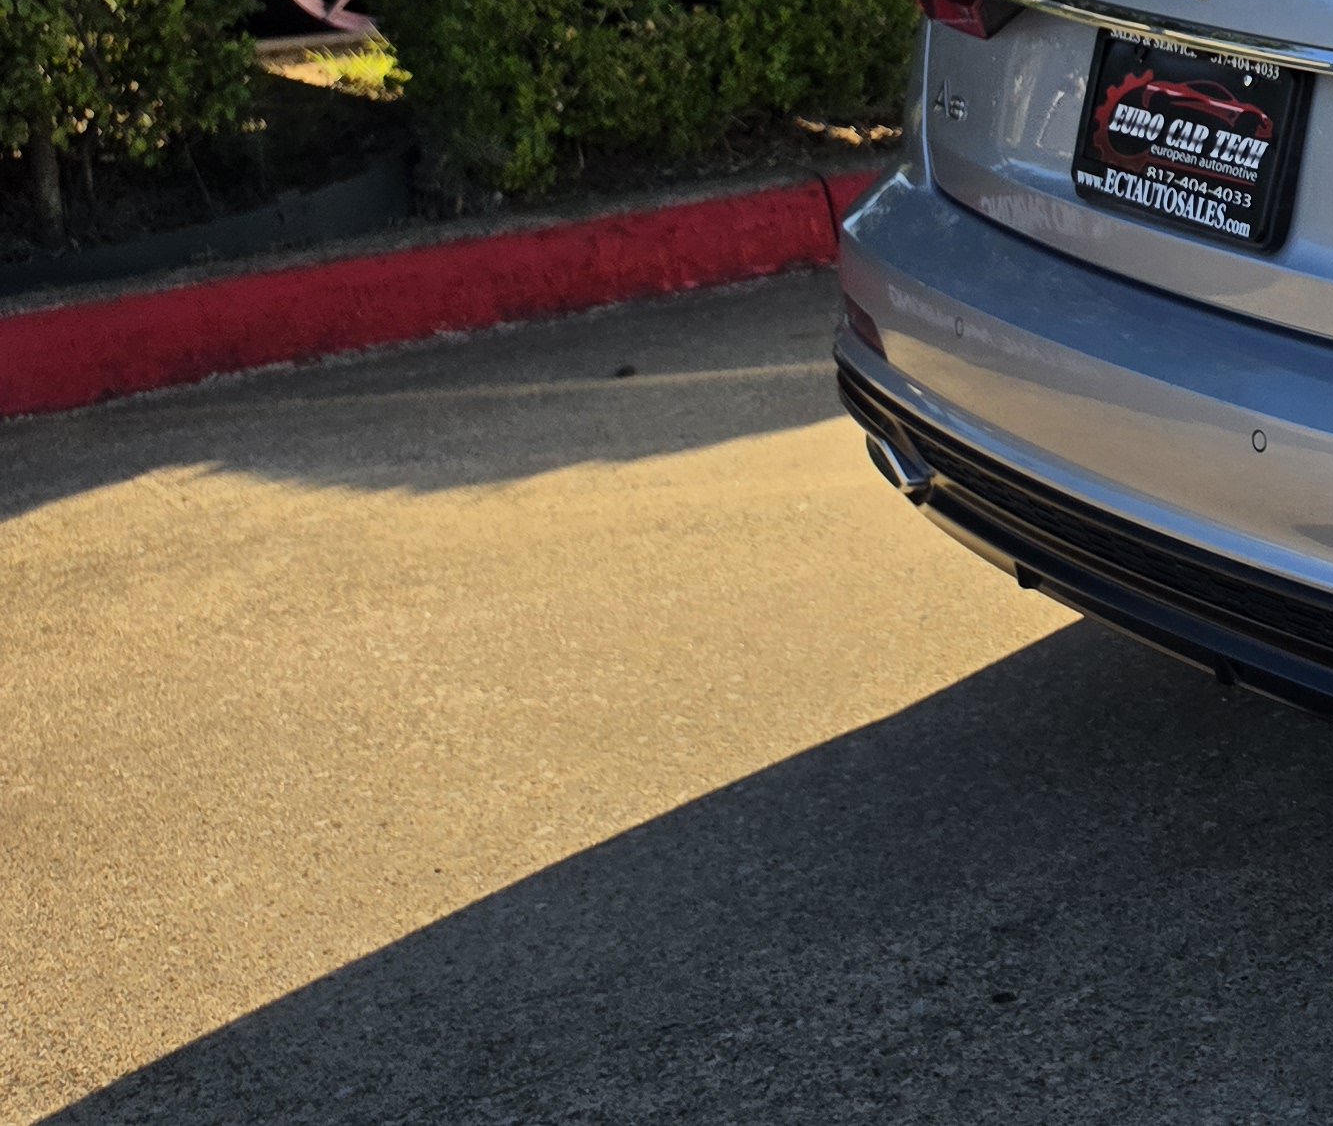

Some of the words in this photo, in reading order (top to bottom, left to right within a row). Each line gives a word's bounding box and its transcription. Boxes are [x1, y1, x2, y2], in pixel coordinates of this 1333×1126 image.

[1109, 103, 1164, 141] EURO
[1165, 118, 1210, 154] CAR
[1210, 129, 1270, 170] TECH
[1150, 143, 1197, 166] european
[1198, 156, 1258, 183] automotive
[1077, 167, 1251, 238] www.ECTAUTOSALES.com
[1146, 166, 1252, 208] 817-404-4033
